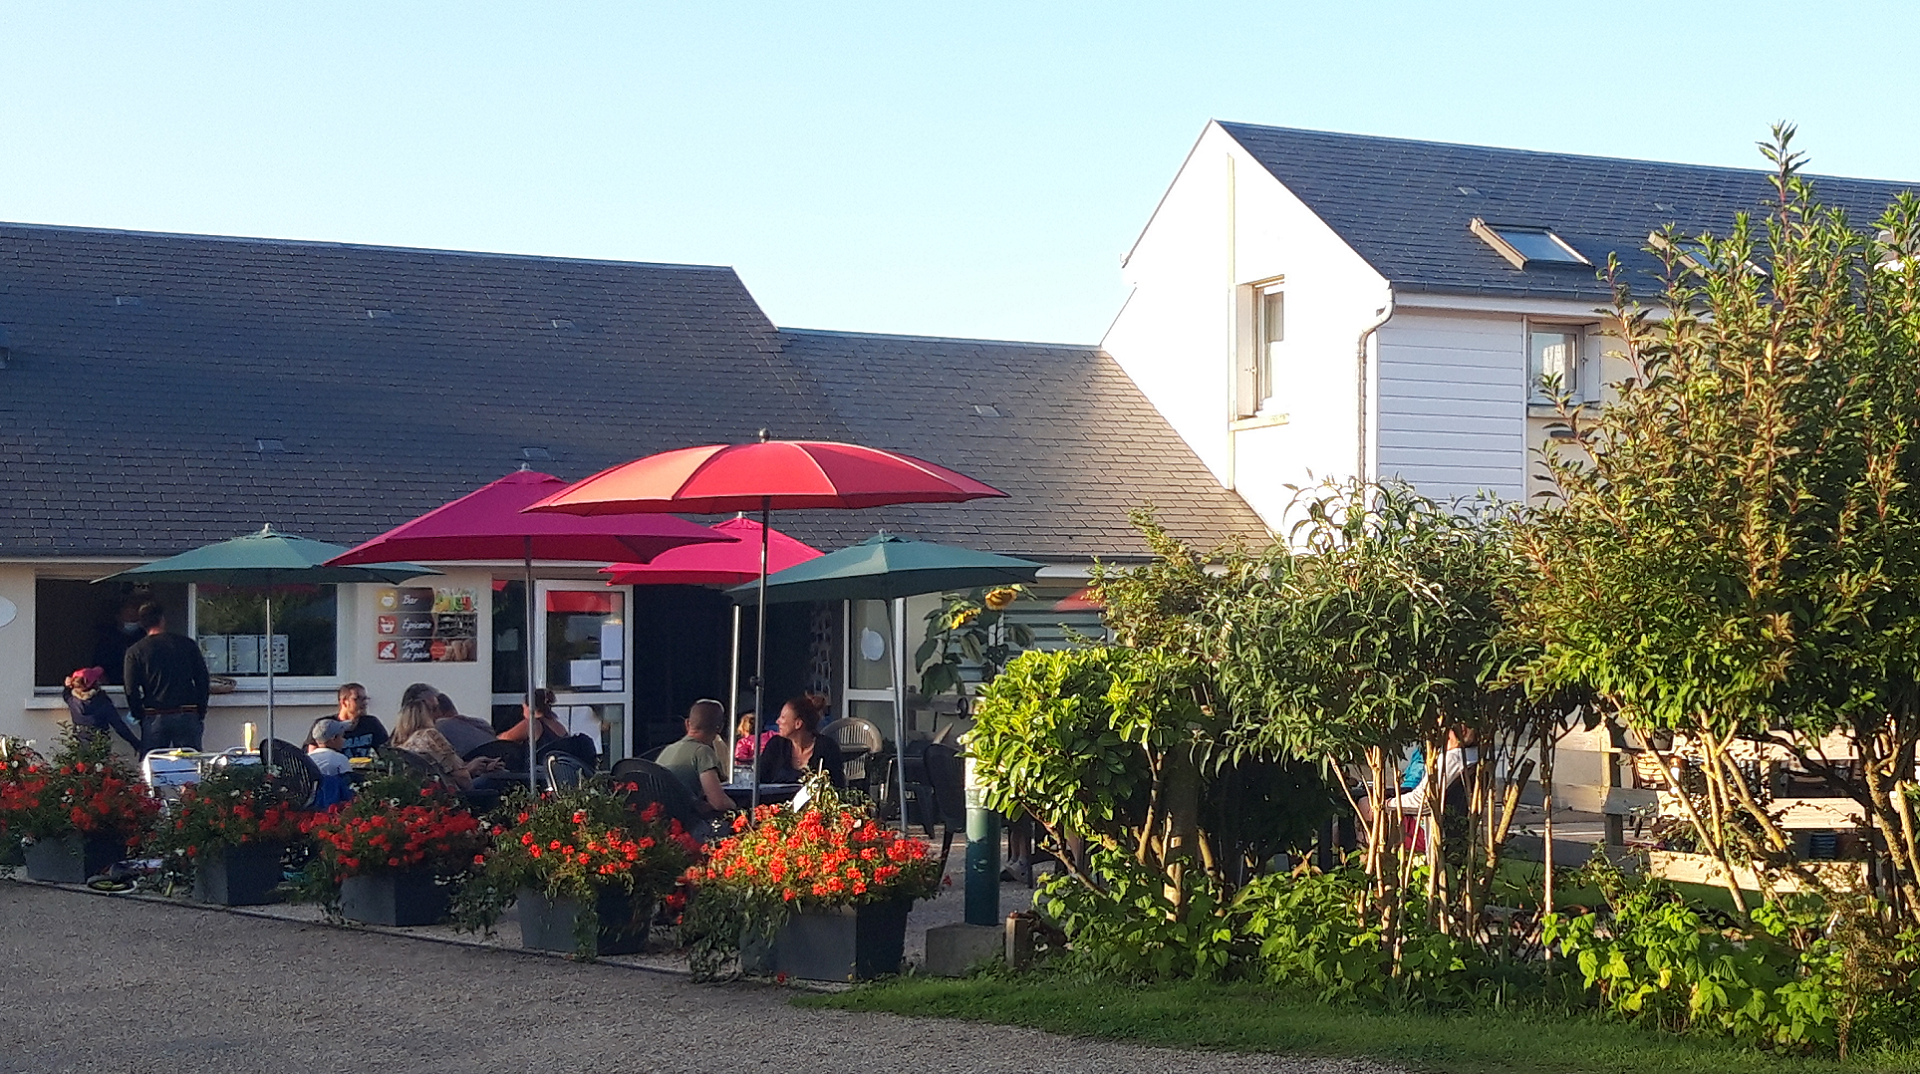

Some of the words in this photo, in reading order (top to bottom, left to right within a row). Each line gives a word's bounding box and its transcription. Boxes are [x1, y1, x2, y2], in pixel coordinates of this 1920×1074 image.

[402, 594, 418, 604] Bar
[402, 650, 412, 659] de
[412, 651, 430, 661] pain
